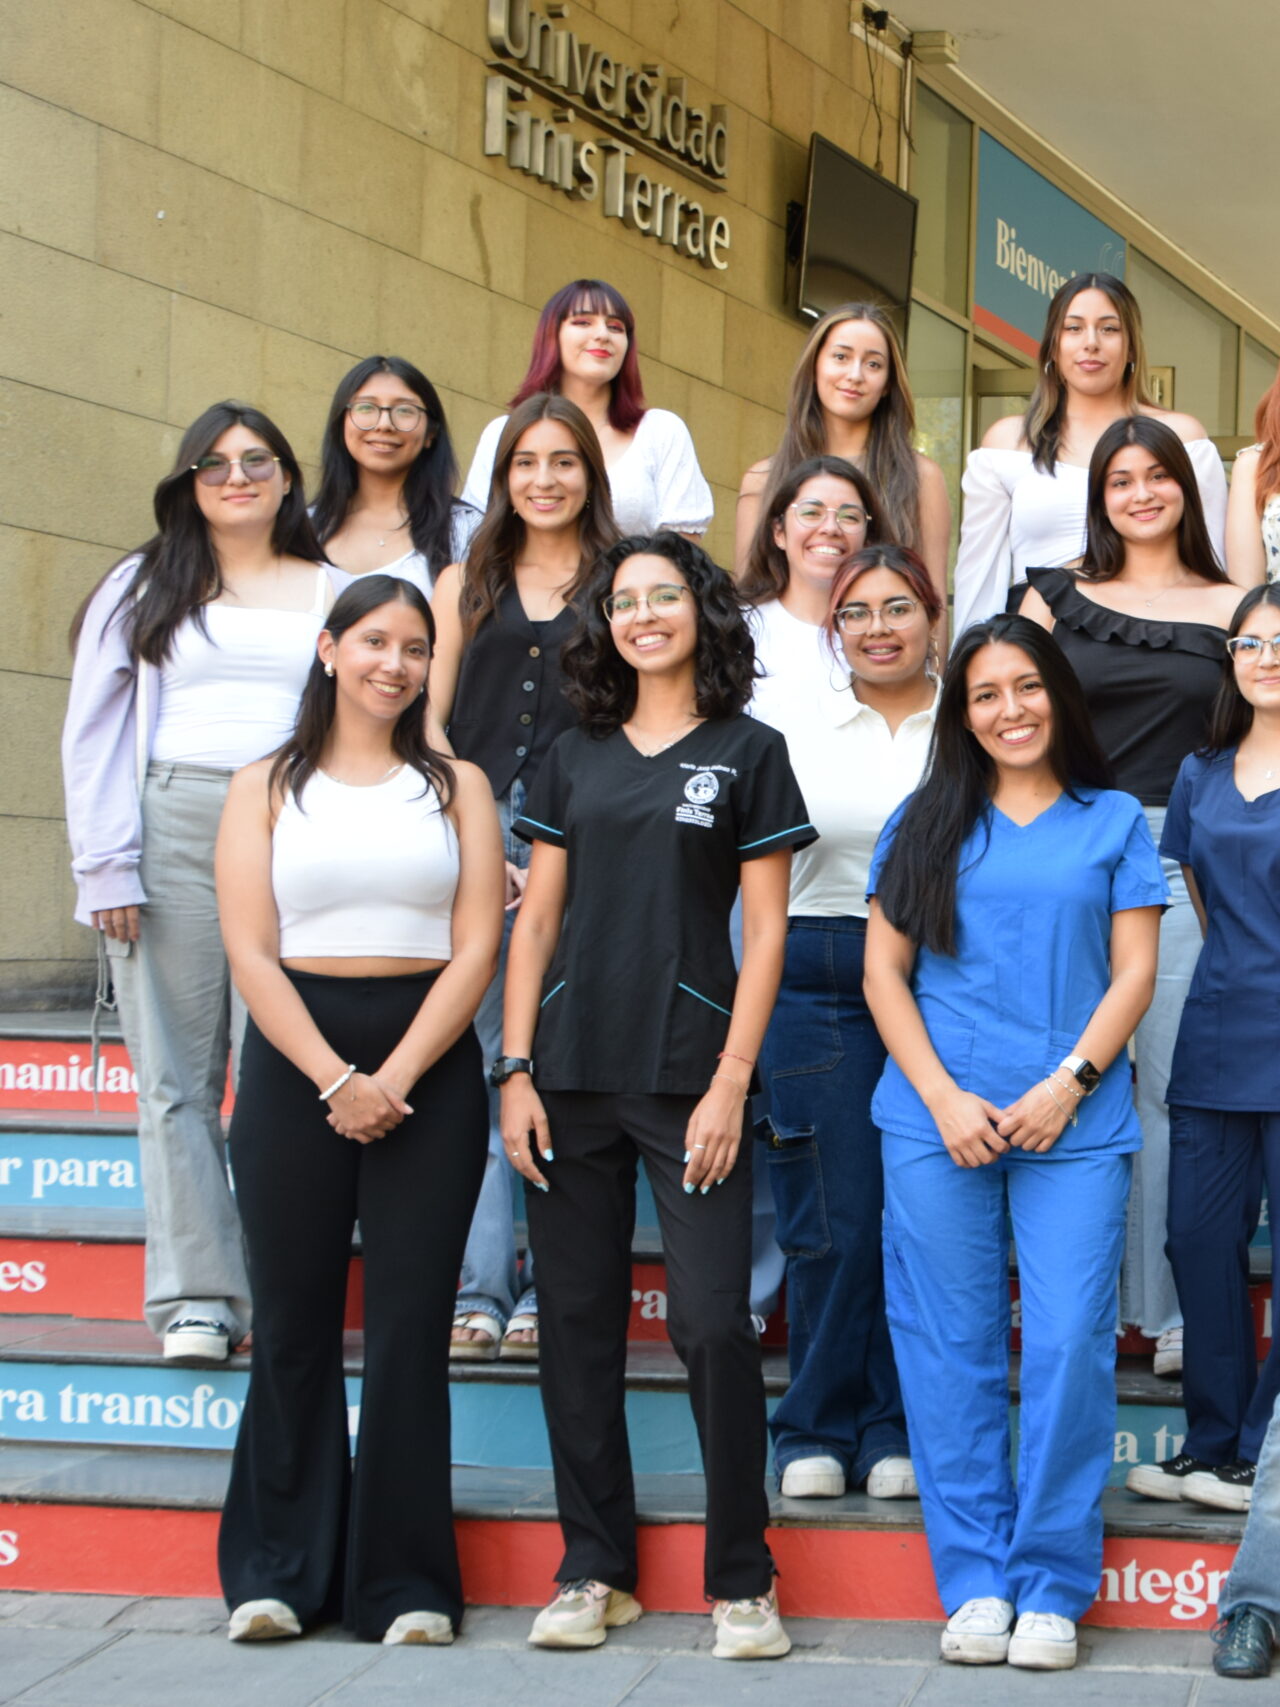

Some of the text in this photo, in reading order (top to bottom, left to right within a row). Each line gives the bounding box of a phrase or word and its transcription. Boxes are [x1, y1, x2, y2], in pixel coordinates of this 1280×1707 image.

[489, 0, 729, 179] Universidad
[484, 75, 731, 270] Finis Terrae
[32, 1153, 136, 1198] para
[59, 1383, 247, 1430] transfo
